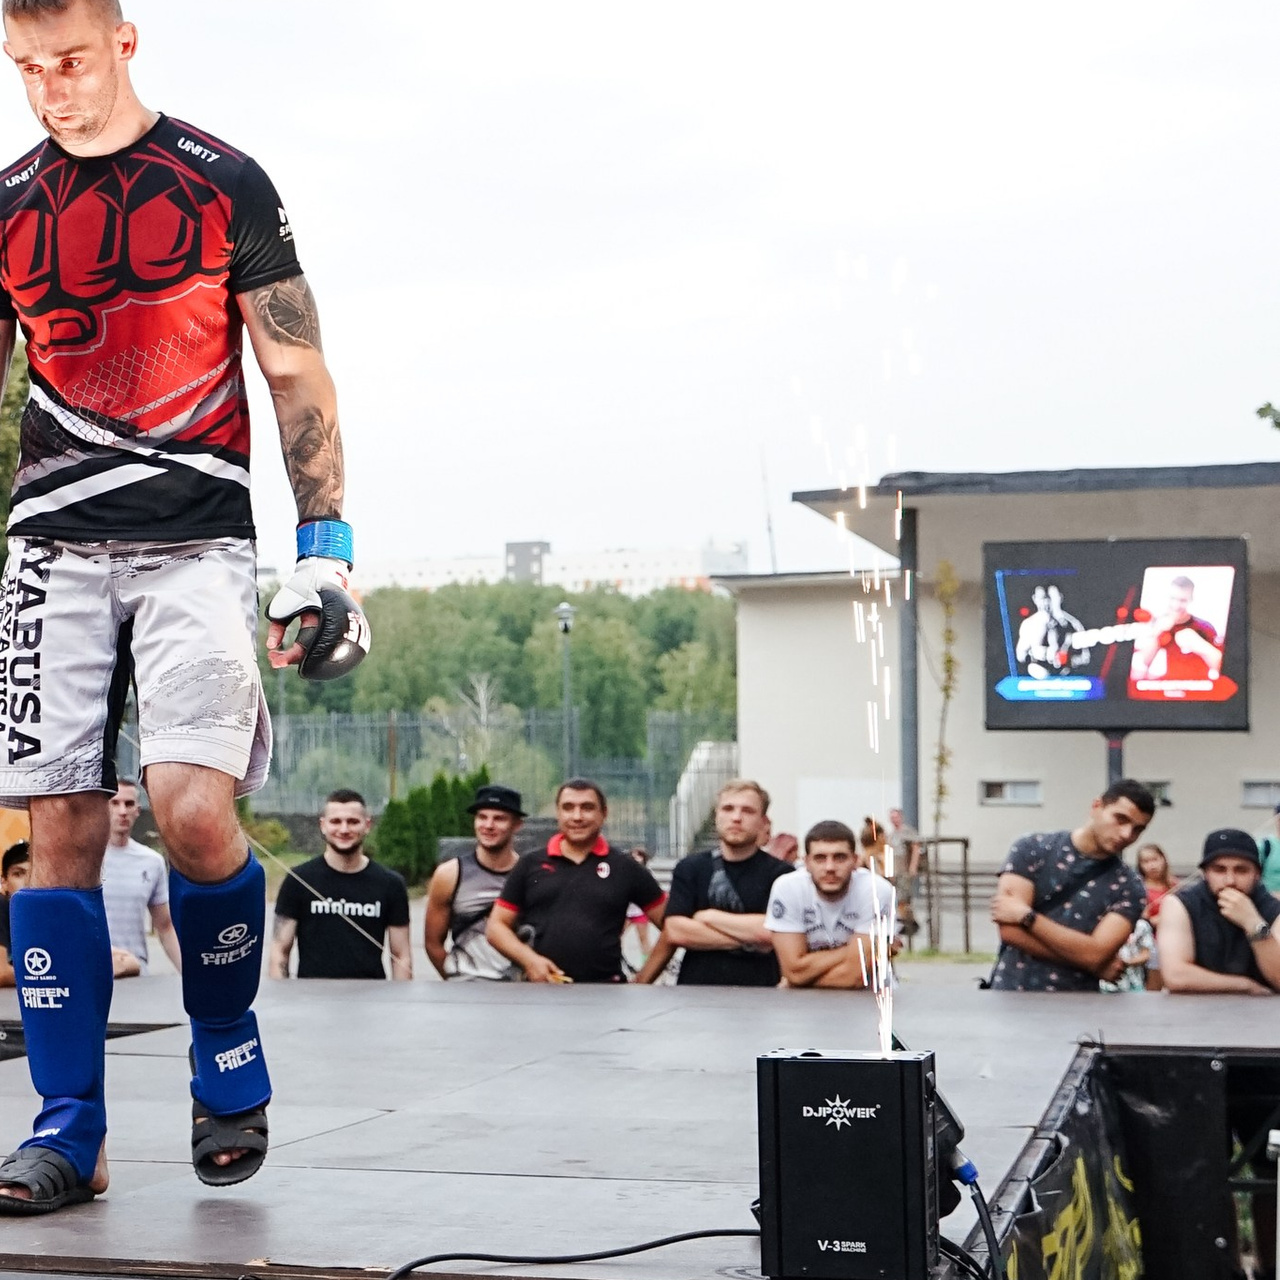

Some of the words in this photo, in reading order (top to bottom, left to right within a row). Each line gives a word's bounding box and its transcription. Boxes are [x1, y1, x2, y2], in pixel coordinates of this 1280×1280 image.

[177, 136, 222, 163] UNITY
[4, 156, 41, 188] UNITY
[310, 896, 381, 918] minimal
[21, 986, 70, 998] GREEN
[23, 996, 63, 1009] HILL
[214, 1037, 258, 1064] GREEN
[218, 1050, 257, 1073] HILL
[817, 1239, 841, 1252] V-3
[841, 1240, 866, 1248] SPARK
